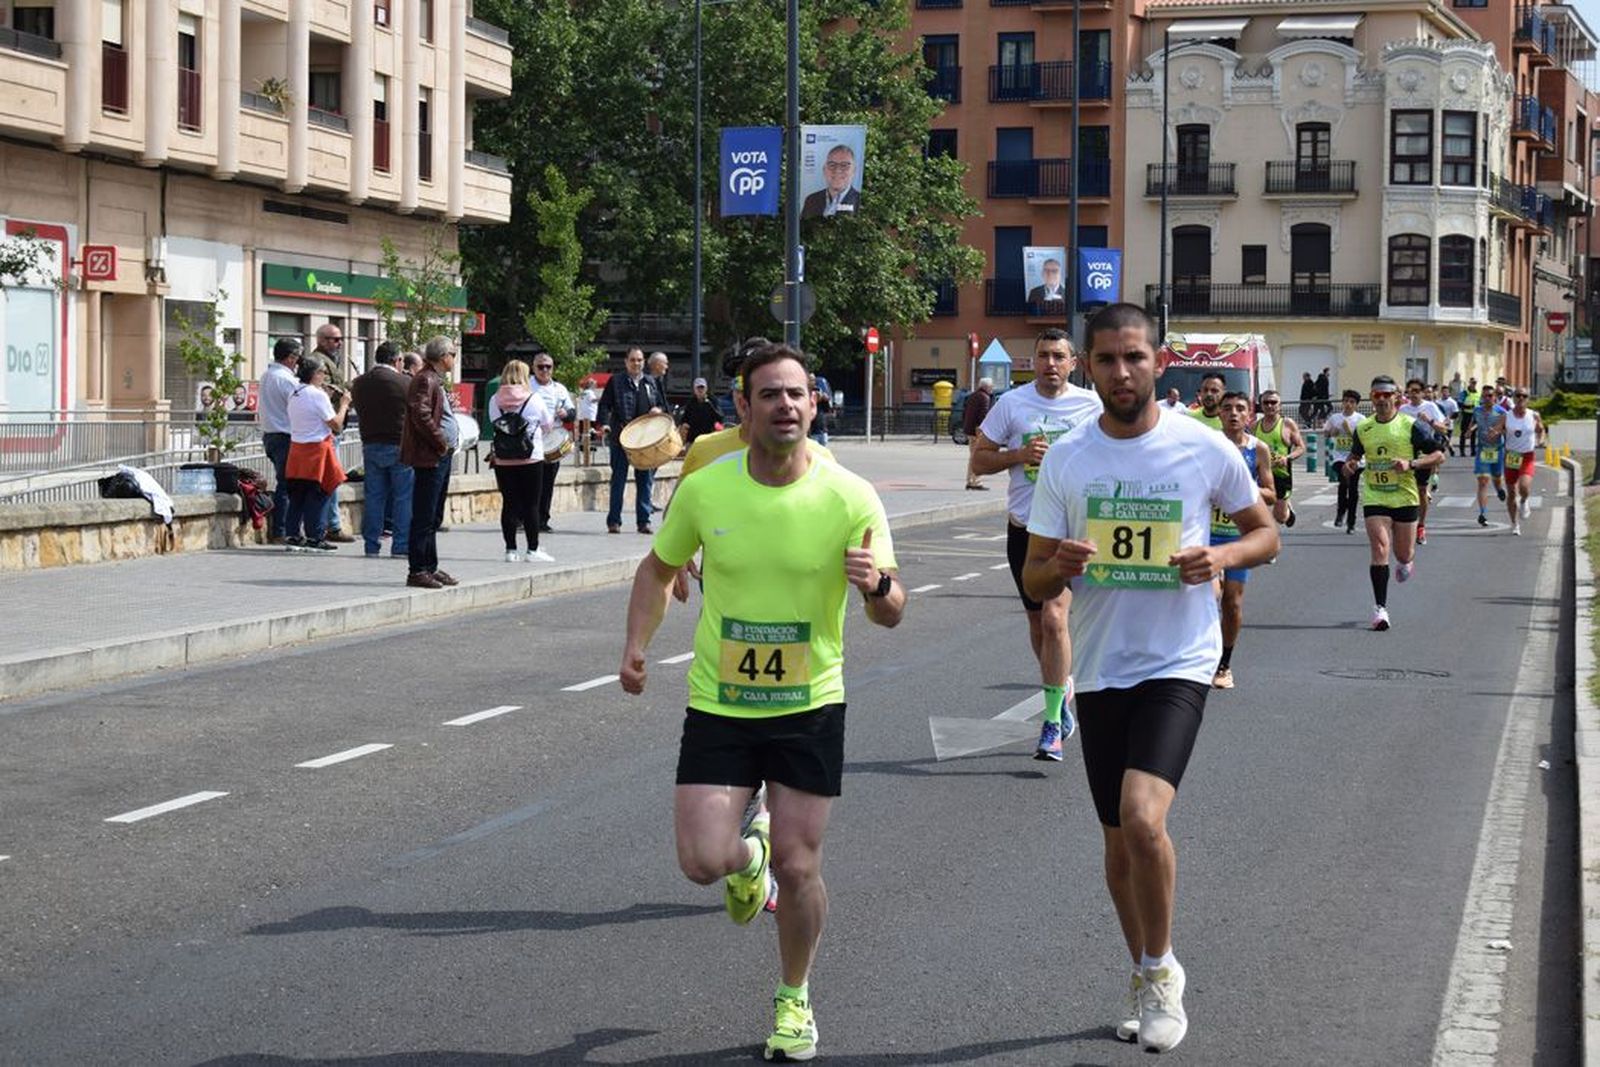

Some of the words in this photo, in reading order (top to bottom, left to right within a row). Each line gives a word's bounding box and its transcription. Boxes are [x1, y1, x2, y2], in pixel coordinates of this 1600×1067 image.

[731, 151, 768, 164] VOTA
[1087, 261, 1113, 271] VOTA
[1374, 472, 1389, 484] 16
[1111, 525, 1152, 561] 81
[1111, 570, 1138, 582] CAJA
[1139, 572, 1175, 583] RURAL
[737, 647, 786, 682] 44
[742, 691, 768, 702] CAJA
[770, 692, 805, 703] RURAL
